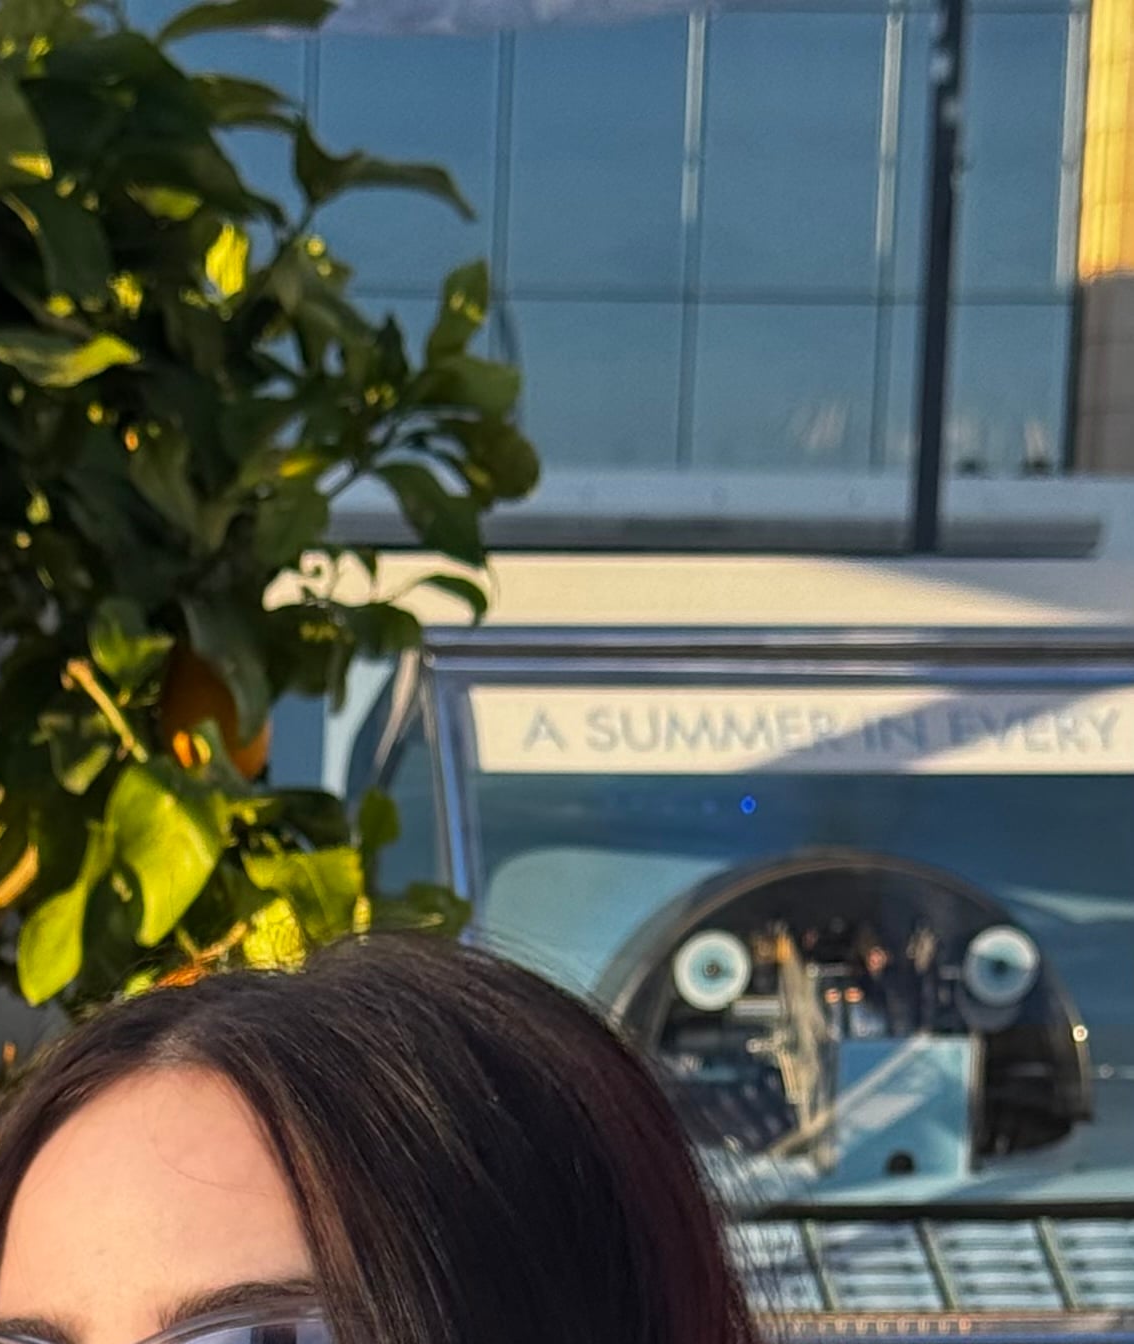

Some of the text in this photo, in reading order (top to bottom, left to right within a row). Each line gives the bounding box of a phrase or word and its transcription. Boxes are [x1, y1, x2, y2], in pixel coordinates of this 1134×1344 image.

[522, 703, 1120, 752] A SUMMER IN EVERY
